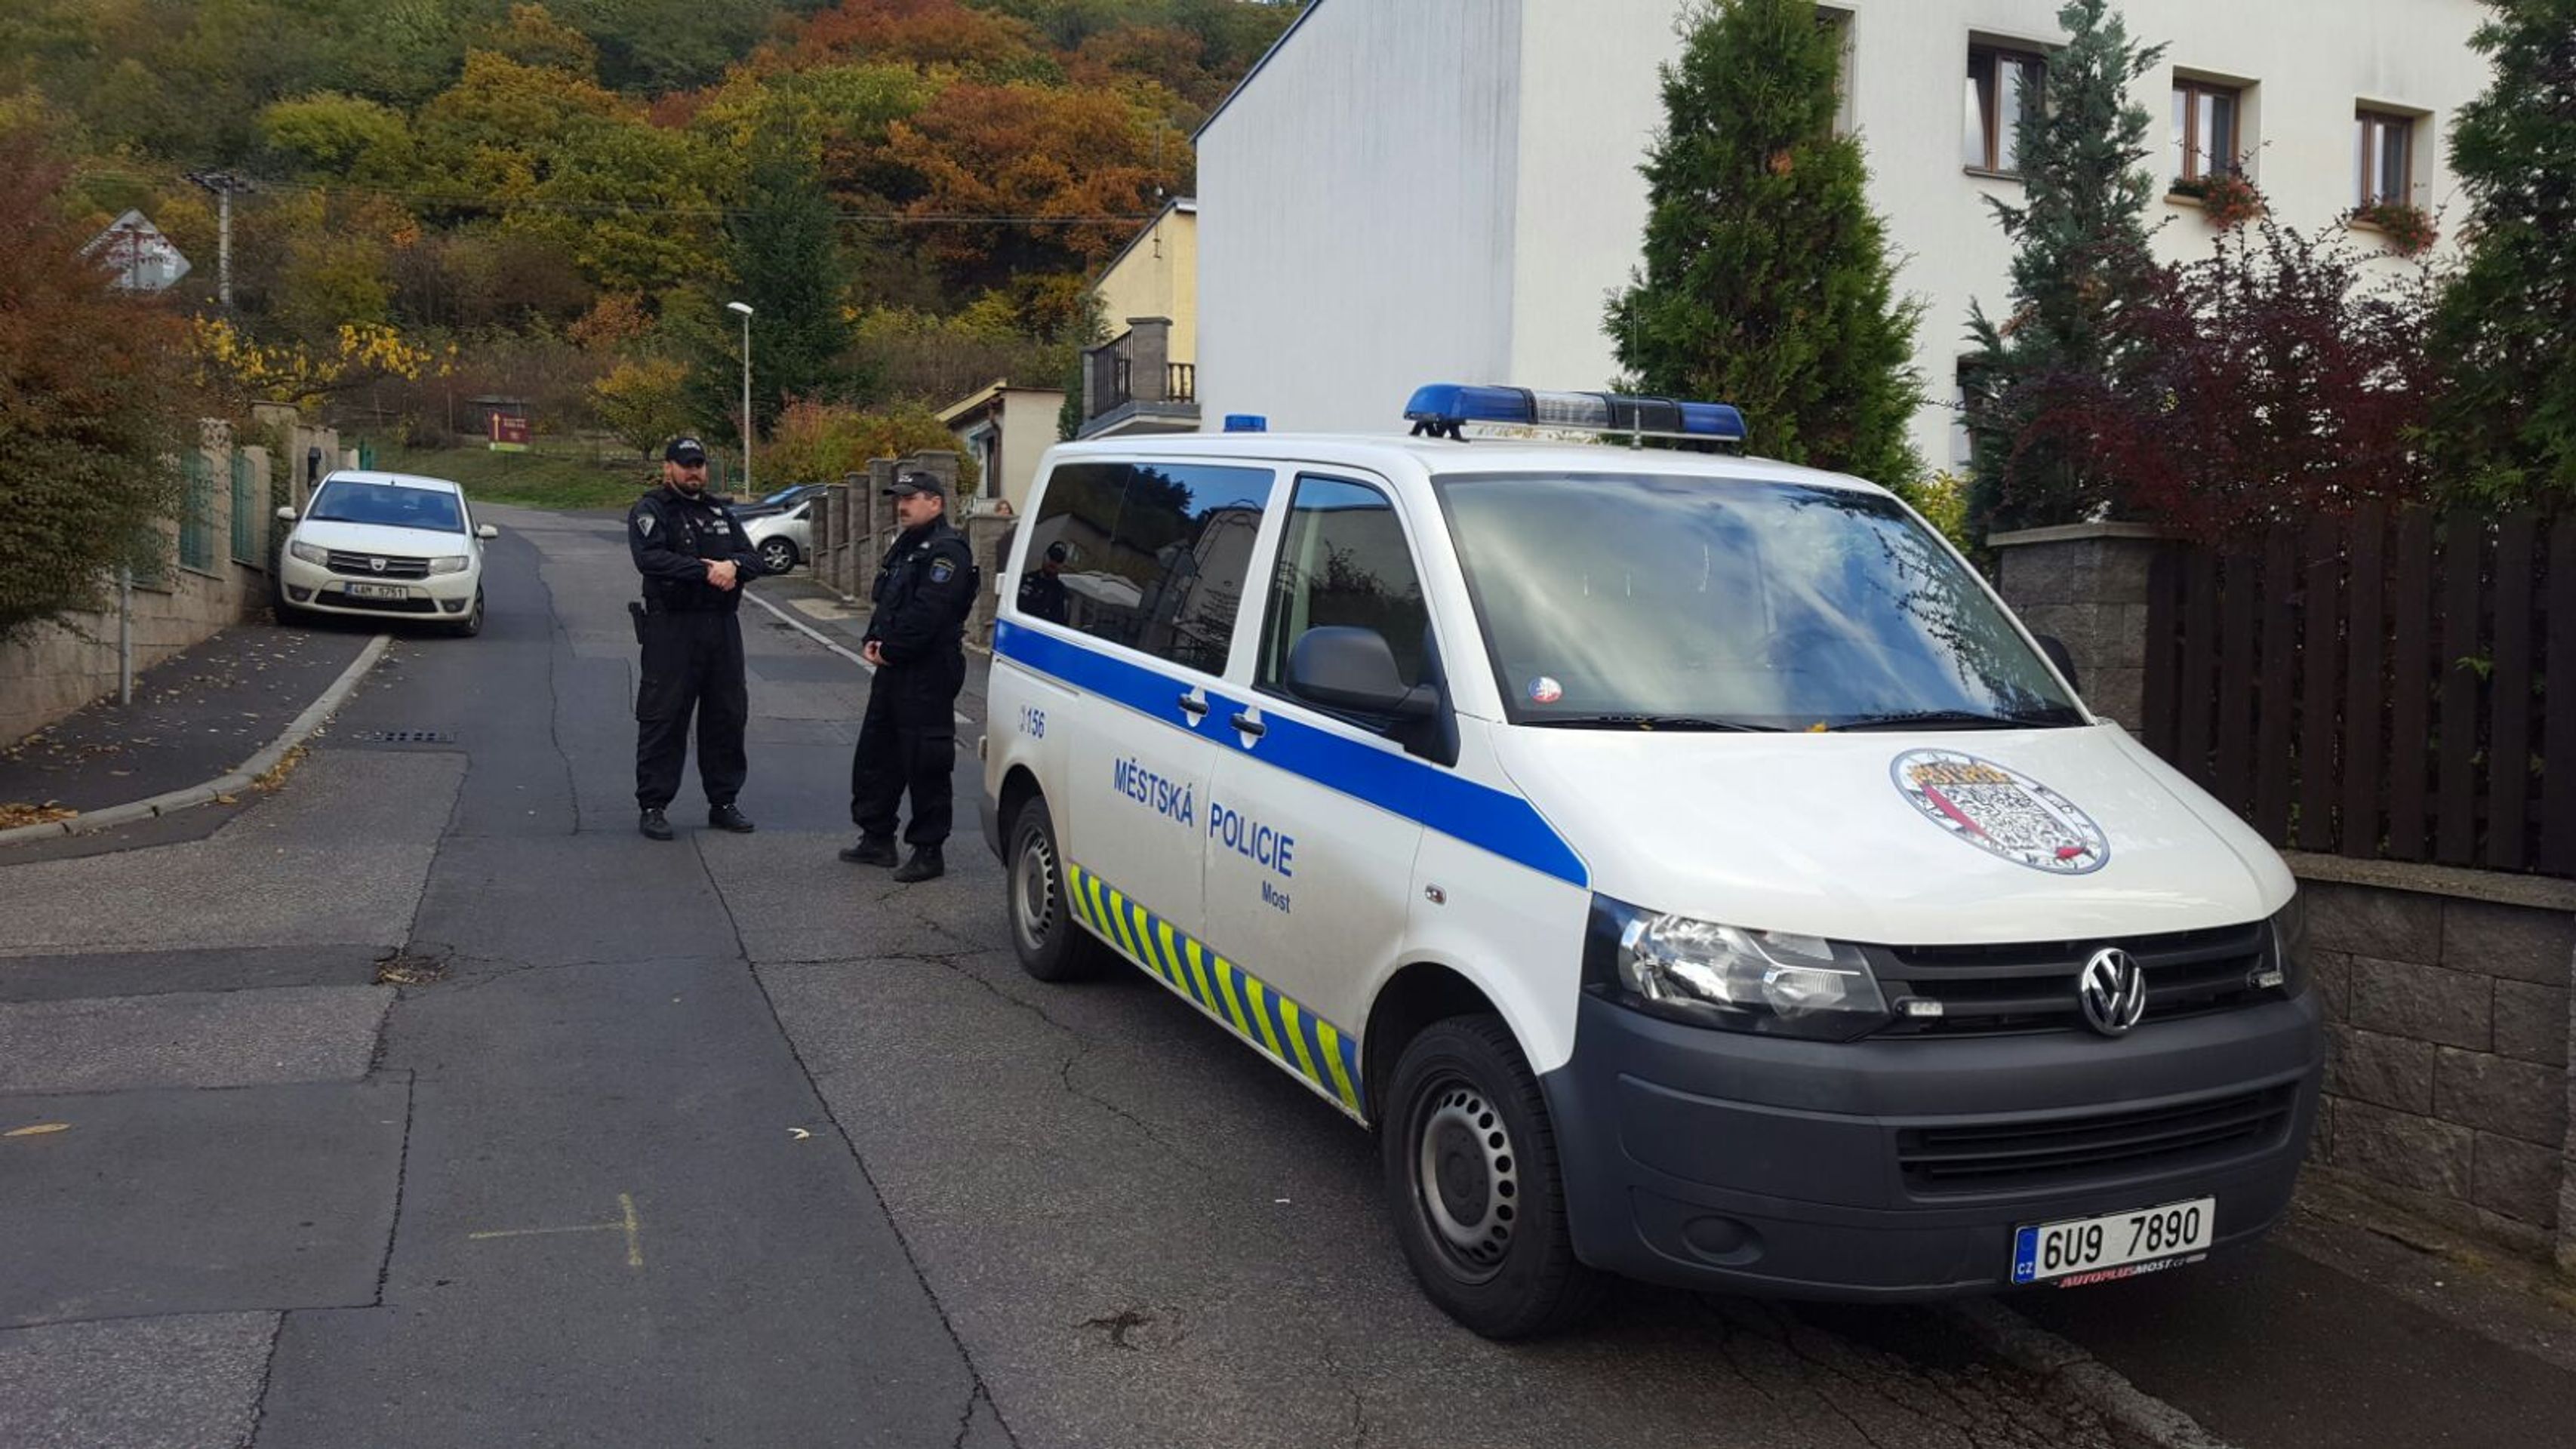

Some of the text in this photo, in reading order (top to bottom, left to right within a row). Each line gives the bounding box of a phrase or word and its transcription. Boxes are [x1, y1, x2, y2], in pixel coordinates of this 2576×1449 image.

[1027, 707, 1045, 740] 156
[1113, 757, 1294, 878] MĚSTSKÁ POLICIE
[1262, 879, 1291, 915] Most
[2044, 1207, 2200, 1270] 6U9 7890
[2017, 1260, 2034, 1275] CZ
